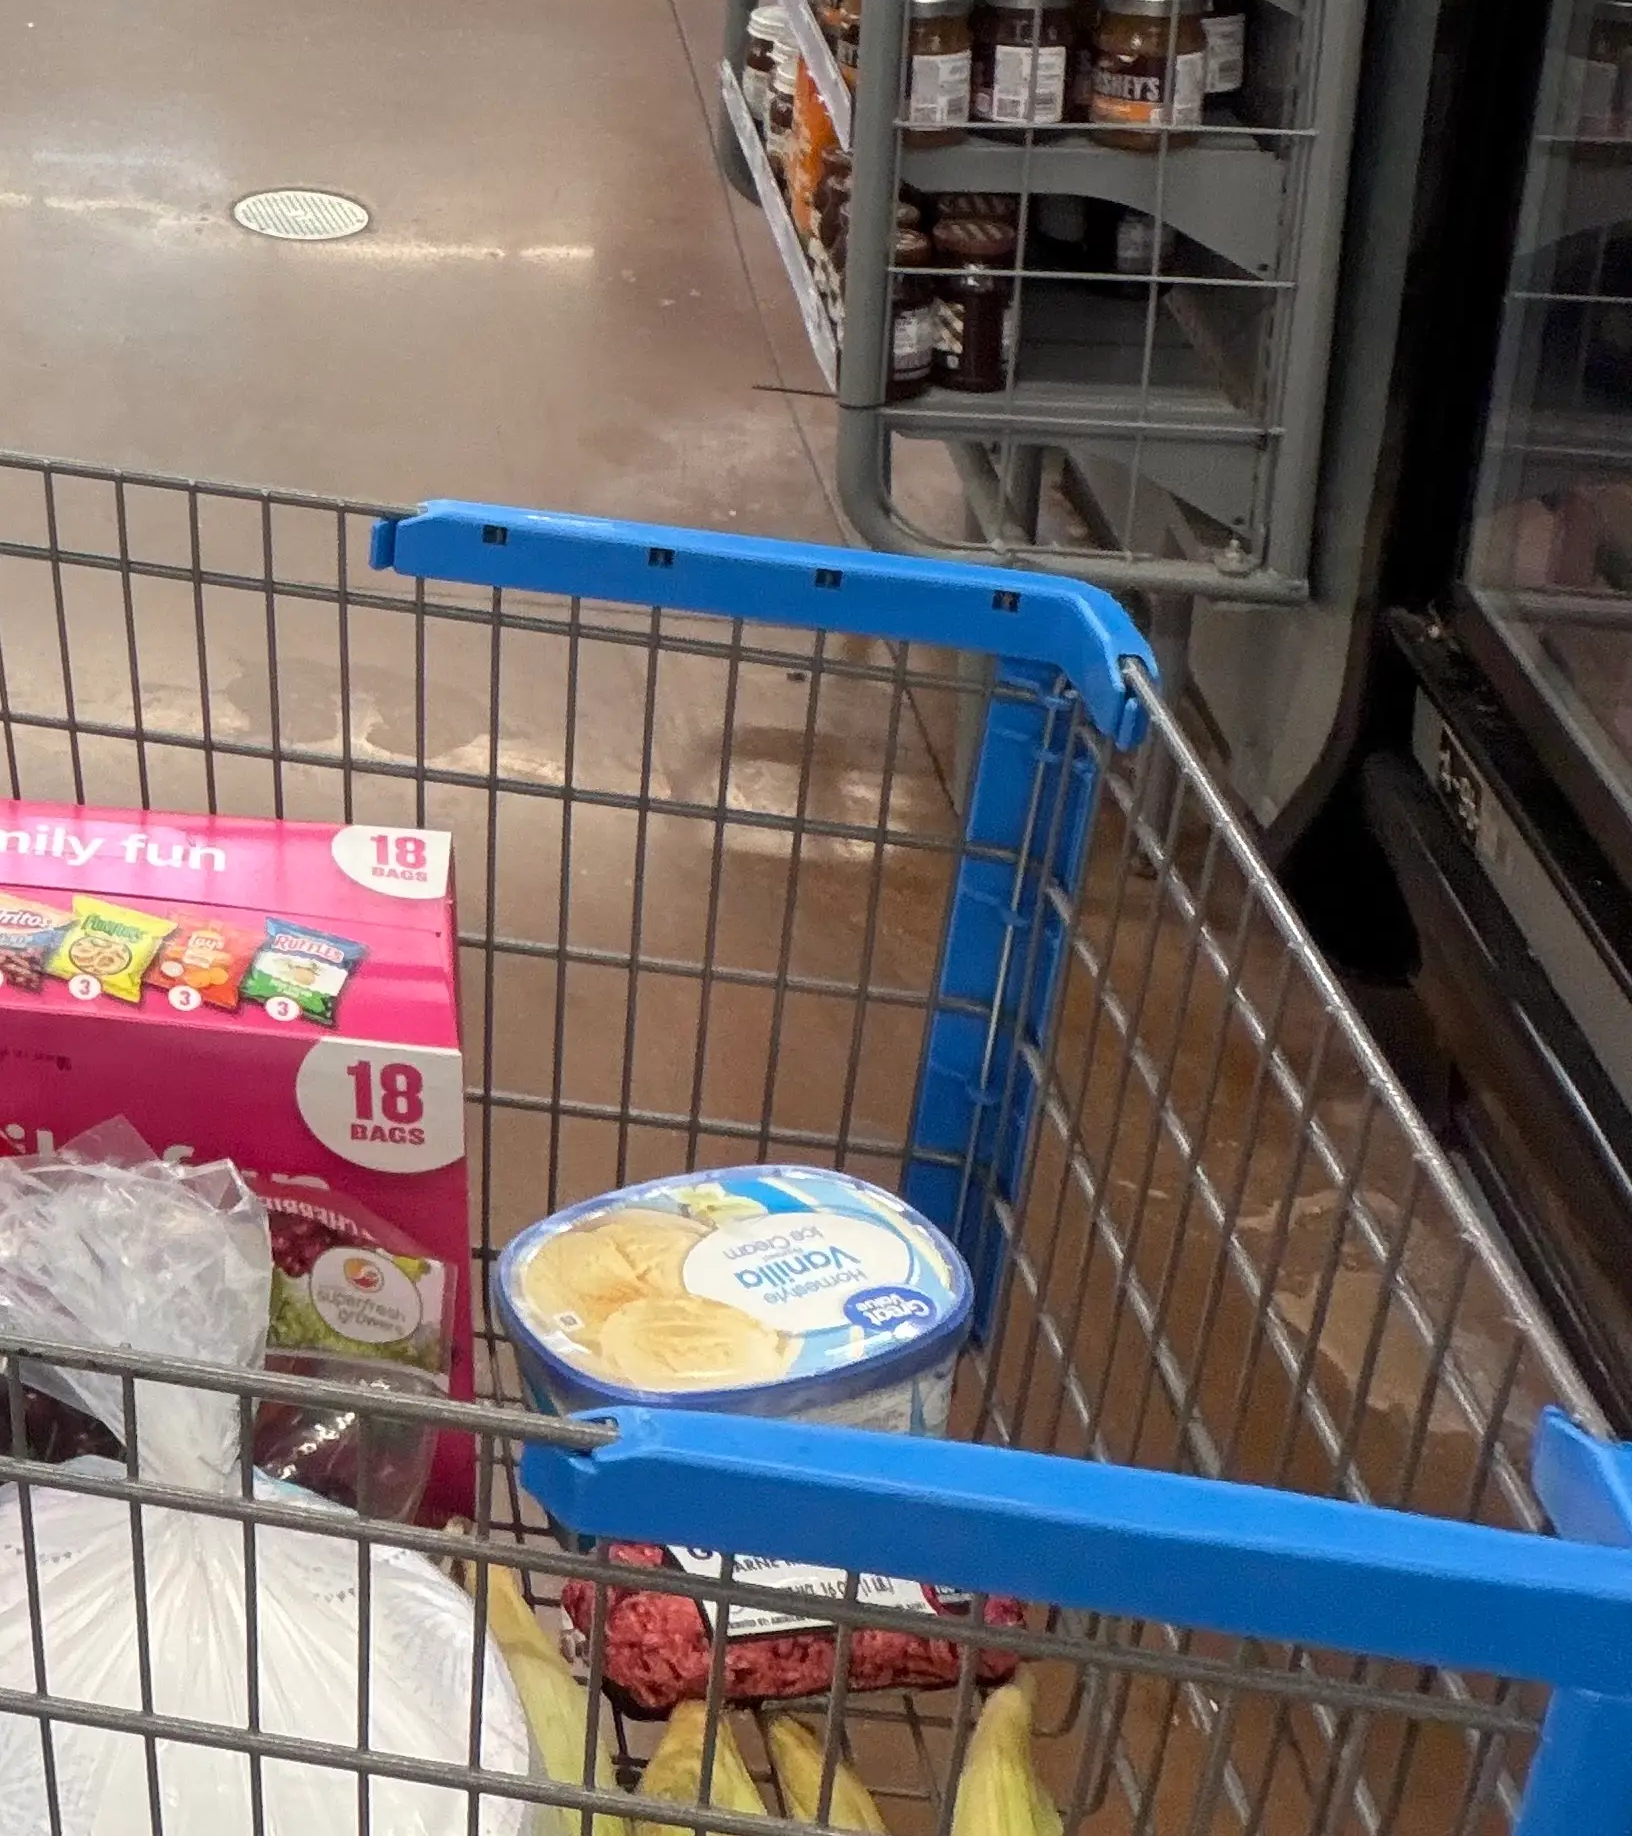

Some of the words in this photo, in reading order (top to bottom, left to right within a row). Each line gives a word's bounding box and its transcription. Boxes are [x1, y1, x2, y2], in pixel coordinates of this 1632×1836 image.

[123, 830, 227, 873] fun
[369, 834, 427, 868] 18
[371, 865, 429, 884] BAGS
[80, 980, 90, 994] 3
[180, 990, 191, 1004] 3
[277, 1002, 288, 1016] 3
[346, 1063, 425, 1124] 18
[349, 1124, 426, 1147] BAGS
[790, 1225, 824, 1241] Ice
[723, 1235, 791, 1260] Cream
[734, 1245, 861, 1289] Vanilla
[763, 1268, 867, 1304] Homestyle
[317, 1288, 406, 1322] superfresh
[855, 1292, 906, 1312] Value
[862, 1299, 929, 1325] Great
[338, 1308, 403, 1336] growers
